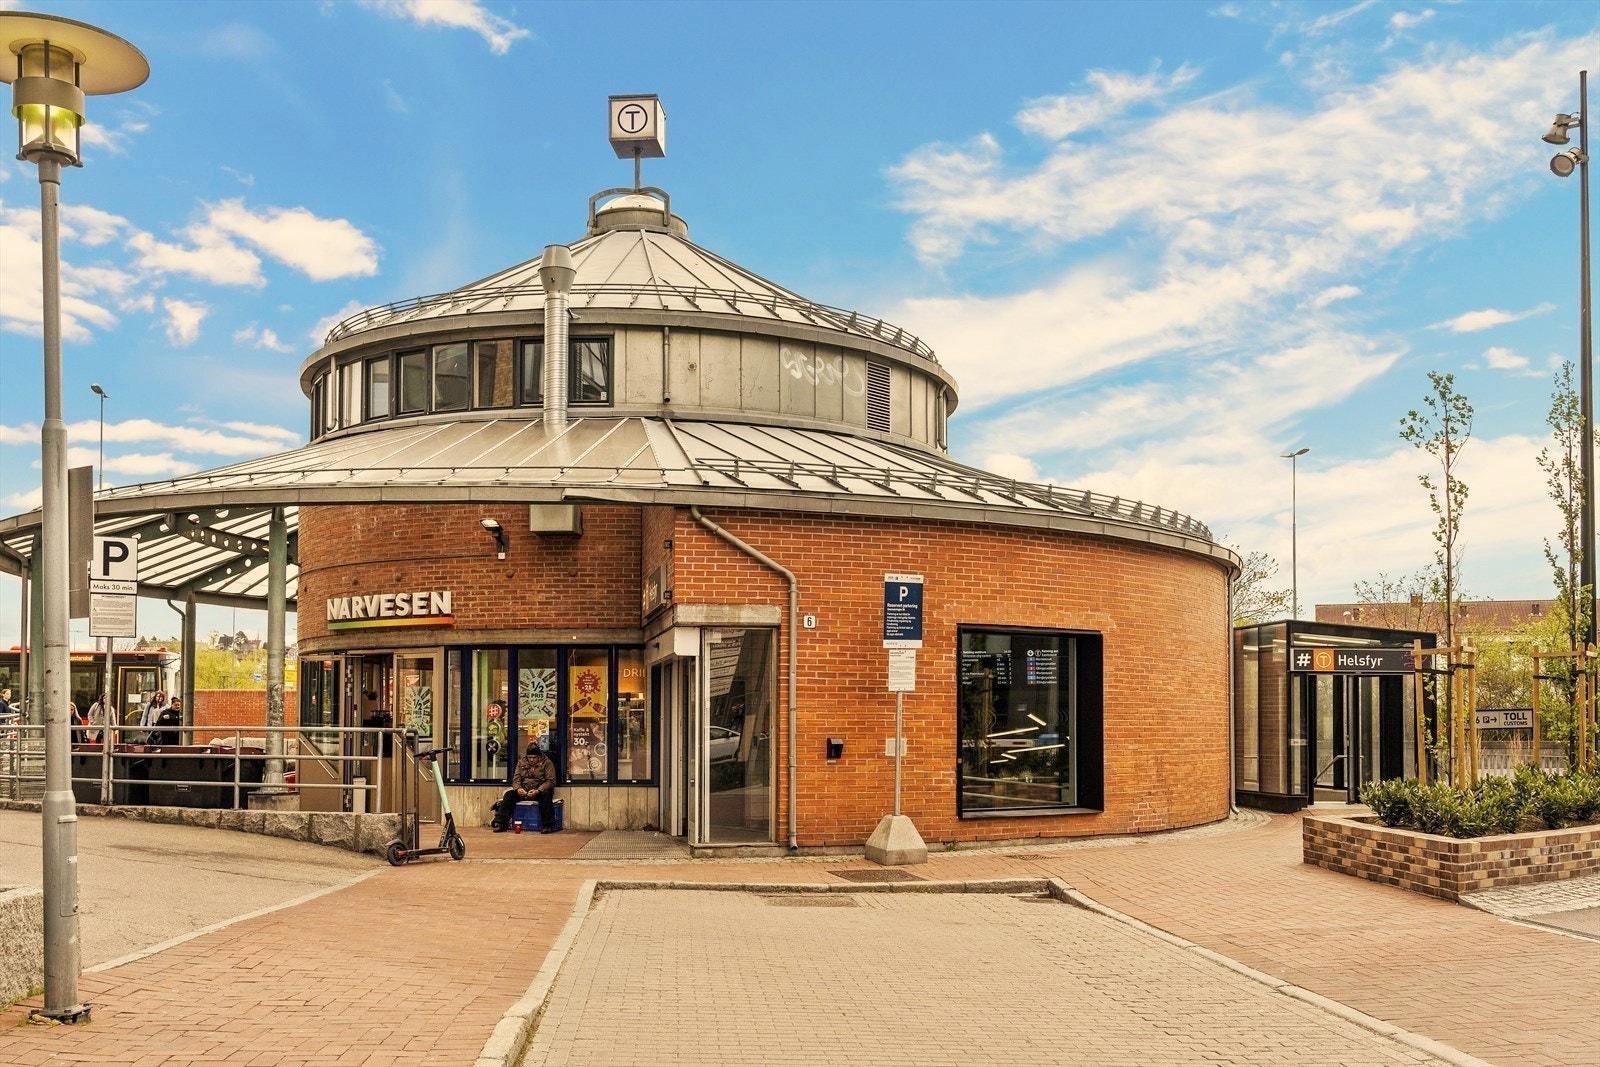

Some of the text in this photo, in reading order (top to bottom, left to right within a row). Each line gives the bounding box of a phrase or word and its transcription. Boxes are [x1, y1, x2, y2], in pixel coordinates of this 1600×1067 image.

[625, 111, 640, 130] T
[102, 541, 129, 576] P
[899, 586, 909, 602] P
[326, 591, 452, 621] NARVESEN
[807, 616, 812, 627] 6
[1338, 655, 1383, 668] Helsfyr
[623, 669, 646, 678] DRI
